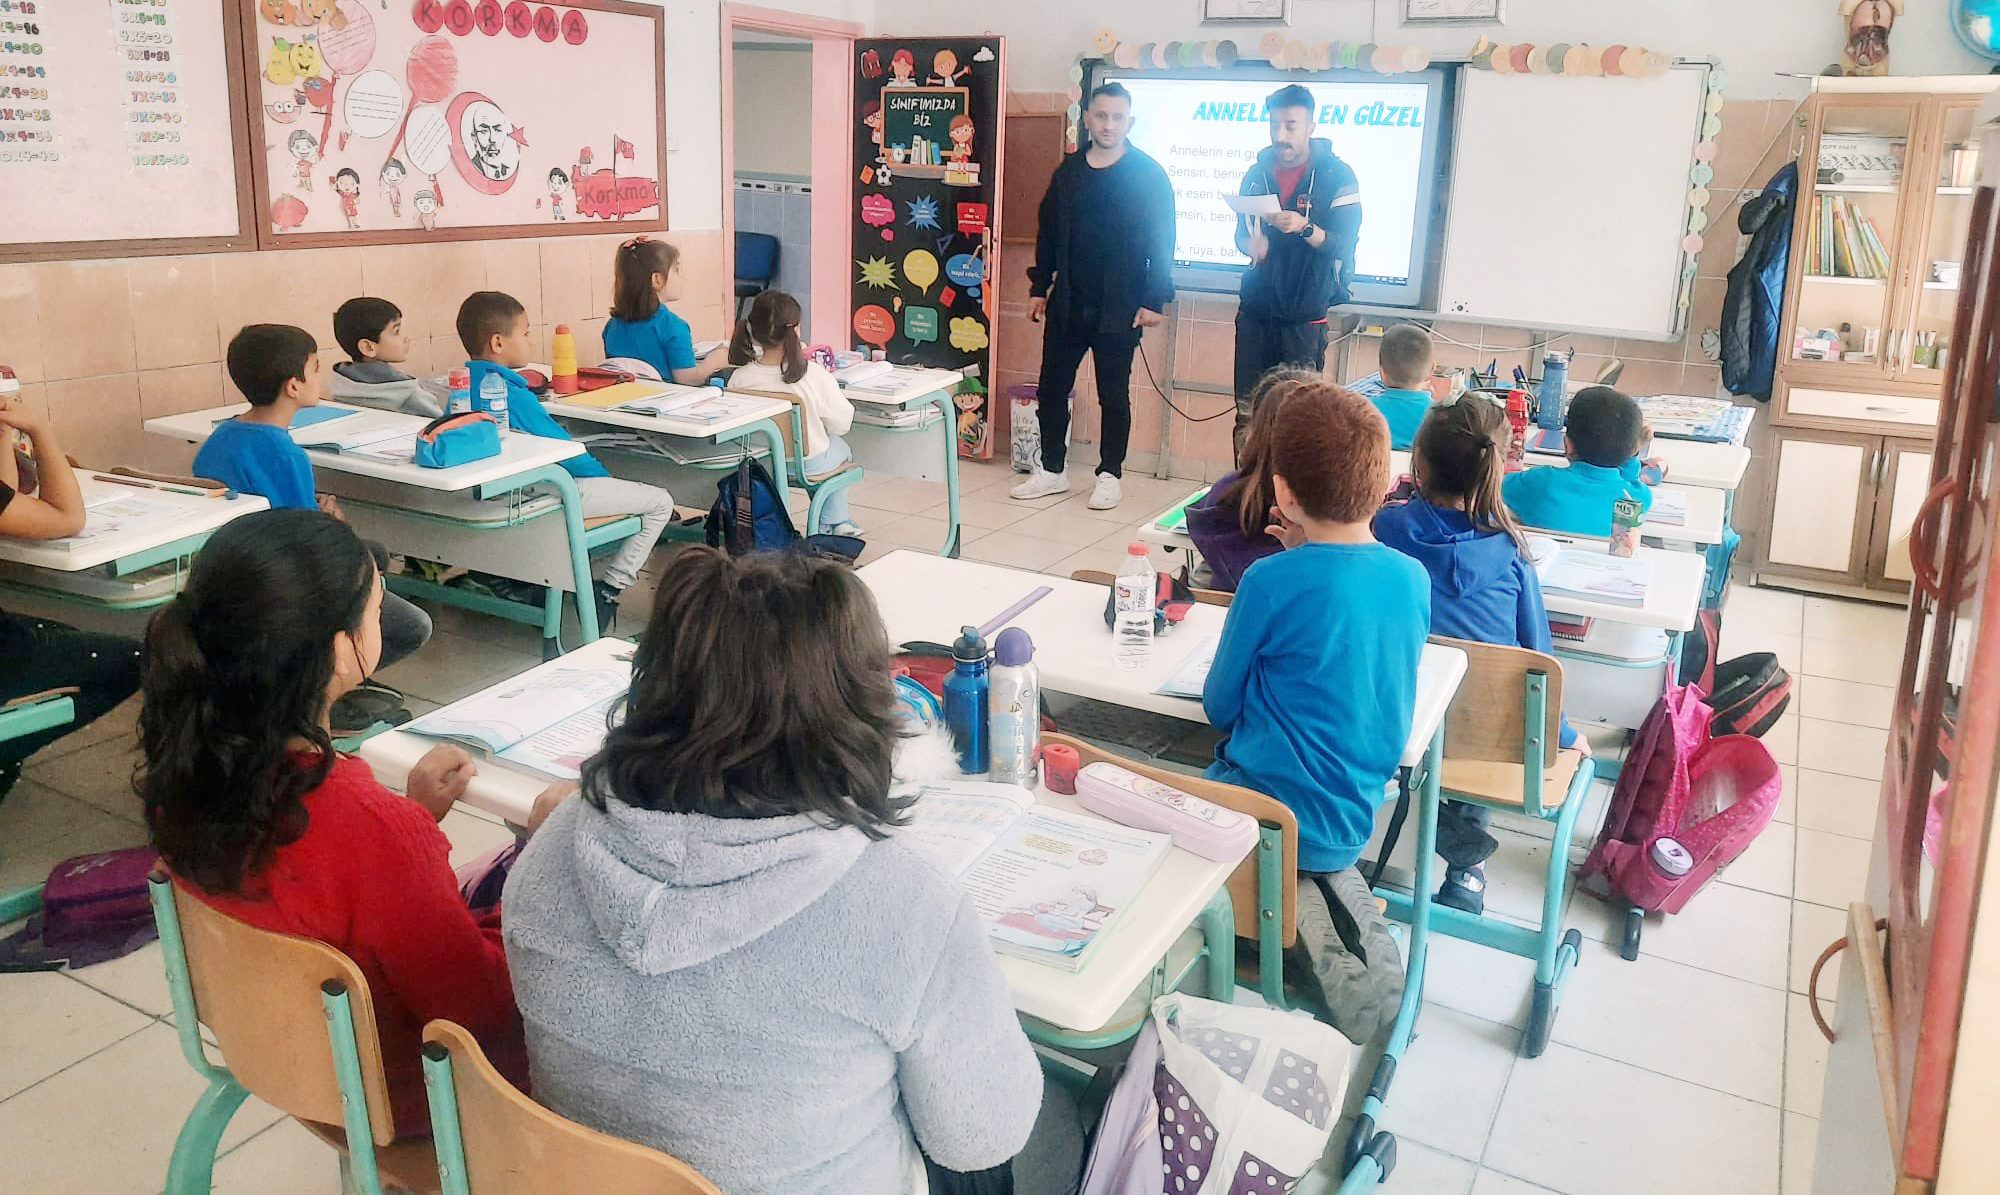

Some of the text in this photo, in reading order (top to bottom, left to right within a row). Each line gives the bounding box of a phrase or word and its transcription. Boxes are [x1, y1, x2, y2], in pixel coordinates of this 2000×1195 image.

[421, 0, 582, 40] KORKMA
[890, 97, 956, 111] SINIFIMIZDA
[913, 111, 931, 126] BİZ
[1318, 104, 1348, 125] EN
[1353, 100, 1423, 128] GÜZEL
[1169, 144, 1223, 159] Annelerin
[1226, 149, 1241, 159] en
[1168, 165, 1209, 179] Sensin,
[584, 184, 649, 205] Korkma
[1186, 189, 1213, 200] esen
[1189, 243, 1217, 257] rüya,
